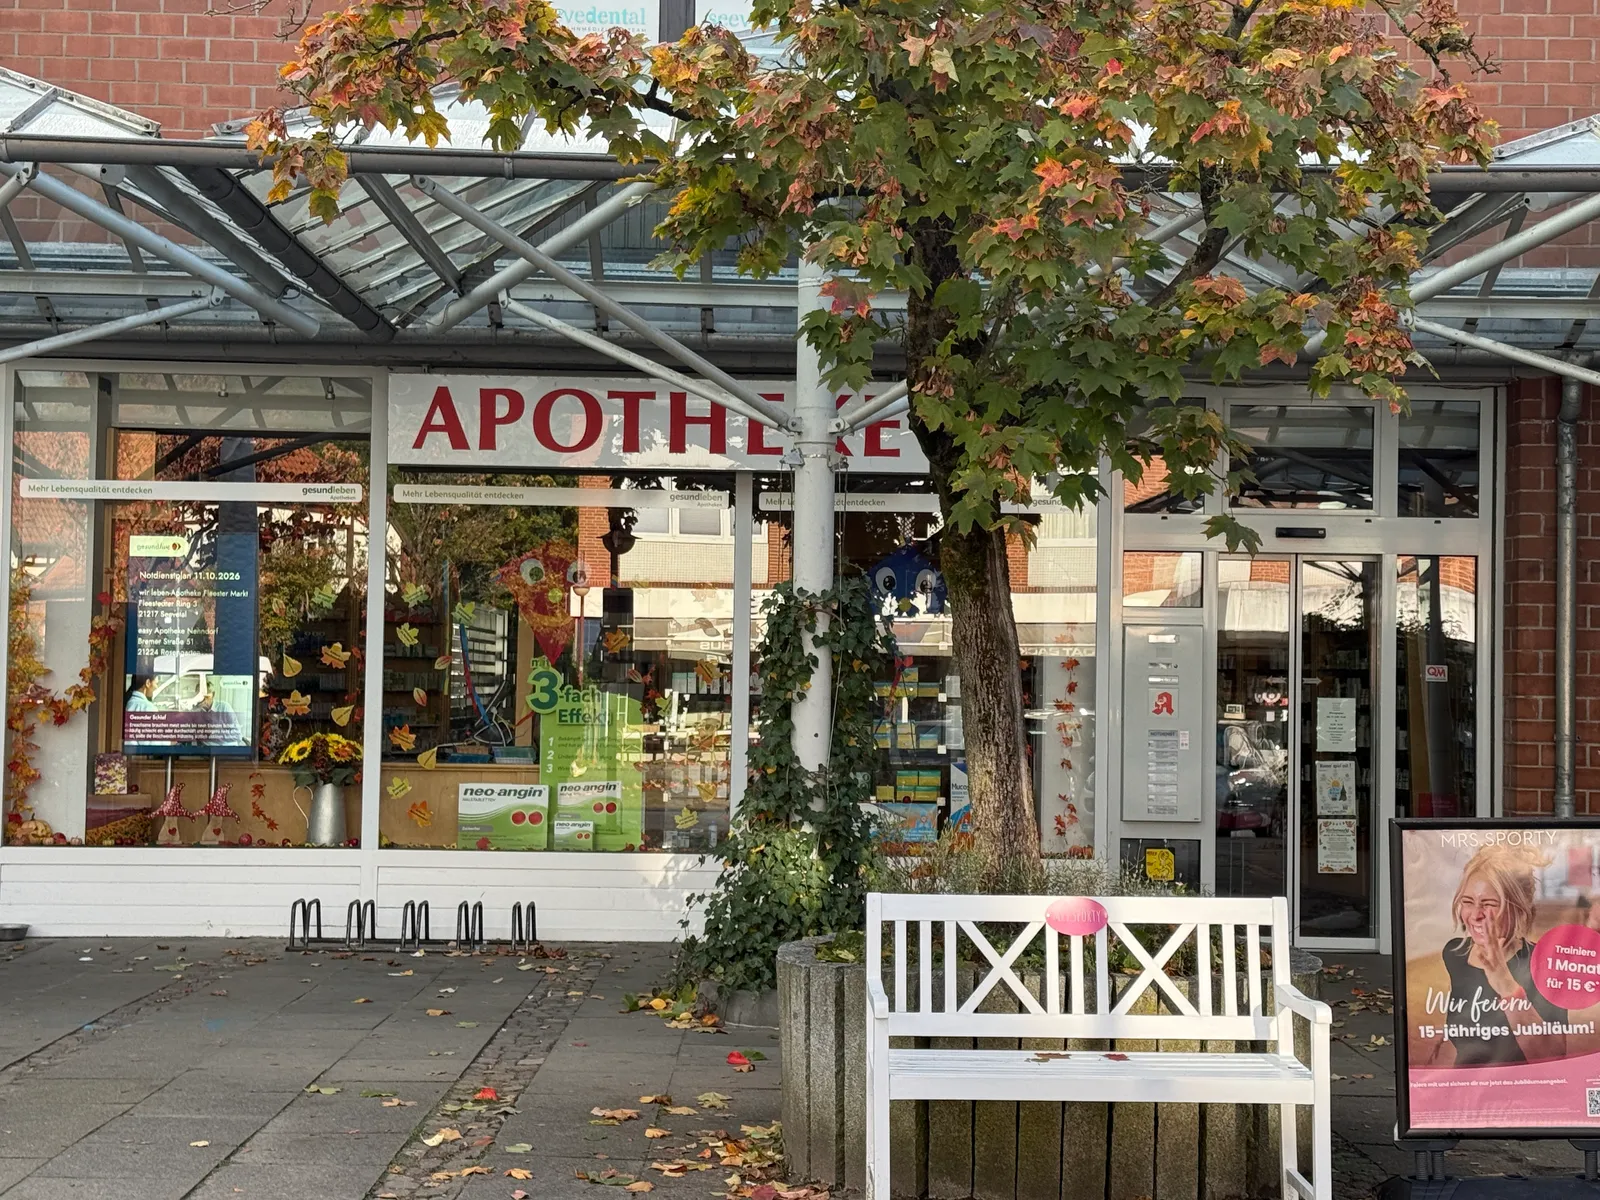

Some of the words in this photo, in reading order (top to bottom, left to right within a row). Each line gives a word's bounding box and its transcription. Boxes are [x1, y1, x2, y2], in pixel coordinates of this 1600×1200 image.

[51, 484, 110, 494] Lebensqualität
[112, 486, 153, 494] entdecken
[302, 486, 356, 496] gesundleben
[402, 489, 423, 498] Mehr
[424, 490, 482, 500] Lebensqualität
[484, 491, 524, 500] entdecken
[669, 493, 722, 502] gesundleben
[765, 498, 785, 506] Mehr
[846, 498, 886, 506] entdecken
[139, 571, 192, 580] Notdienstplan
[194, 572, 241, 580] 11.10.2026
[138, 610, 159, 618] 21217
[951, 782, 968, 790] Muco
[1441, 830, 1557, 848] MRS.SPORTY
[1555, 944, 1597, 957] Trainiere
[1547, 957, 1553, 970] 1
[1546, 977, 1564, 989] für
[1566, 977, 1582, 991] 15
[1425, 986, 1468, 1015] Wir
[1470, 985, 1532, 1023] feiern
[1418, 1024, 1510, 1041] 15-jähriges
[1512, 1021, 1595, 1037] Jubiläum!
